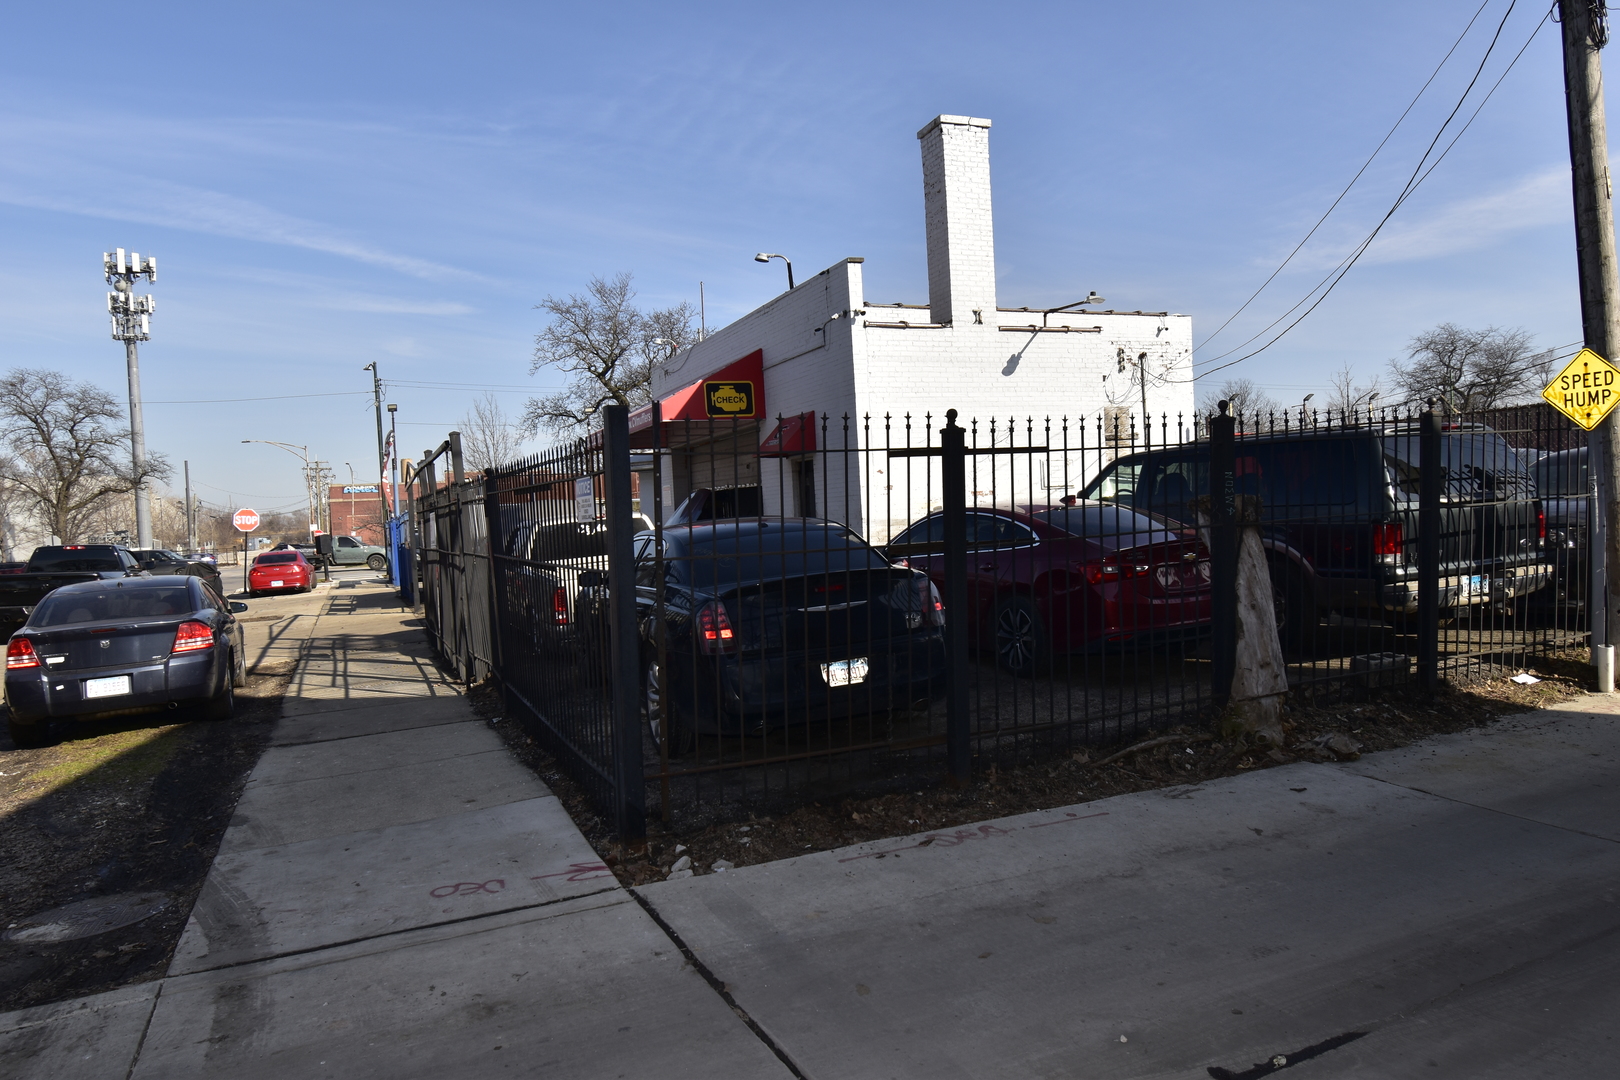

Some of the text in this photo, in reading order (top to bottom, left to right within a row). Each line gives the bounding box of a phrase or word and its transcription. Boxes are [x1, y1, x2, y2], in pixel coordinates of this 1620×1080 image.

[1561, 370, 1614, 390] SPEED
[716, 395, 745, 404] CHECK
[1564, 389, 1611, 408] HUMP
[235, 515, 258, 525] STOP
